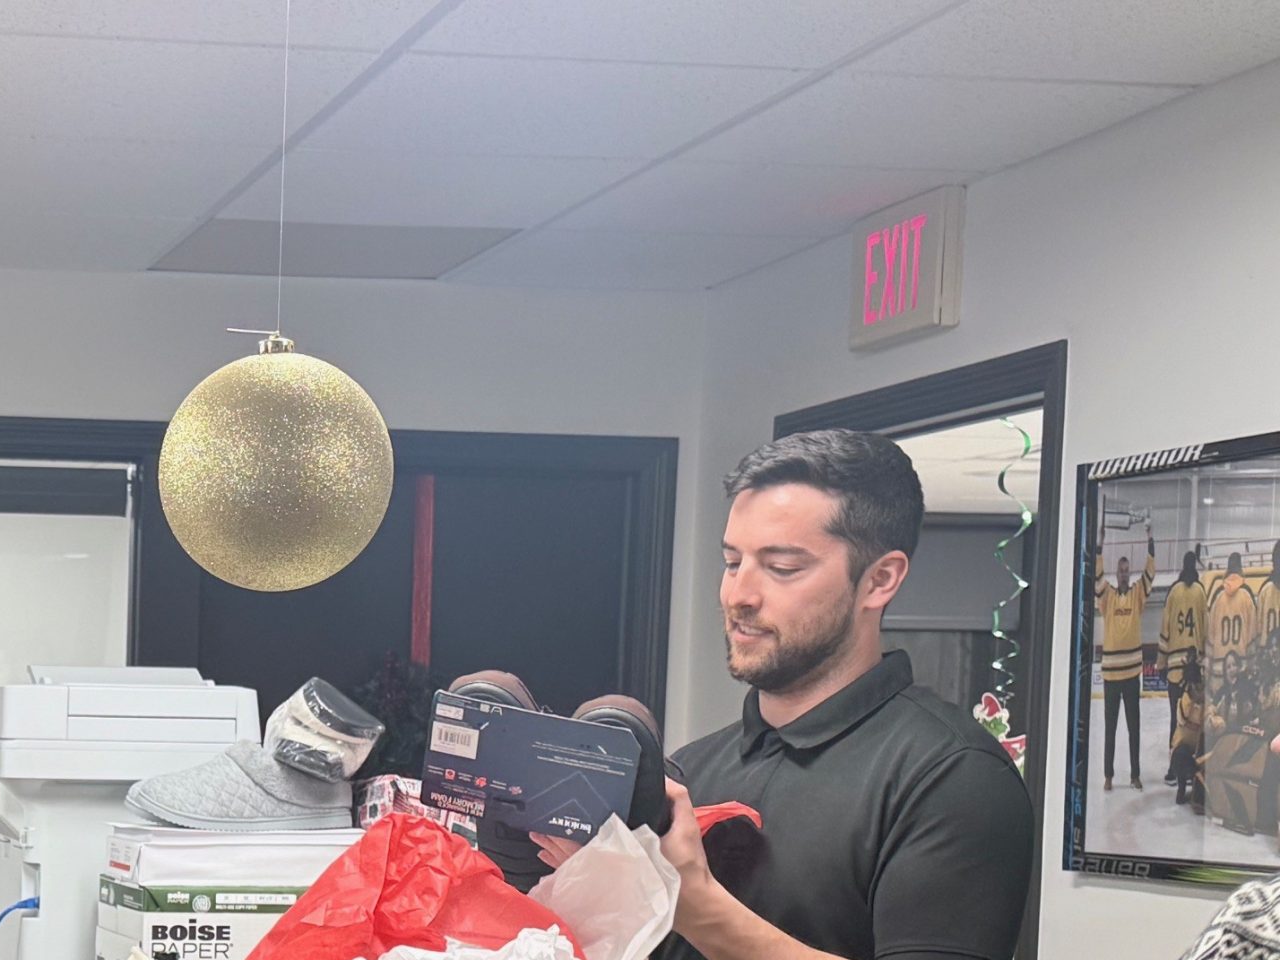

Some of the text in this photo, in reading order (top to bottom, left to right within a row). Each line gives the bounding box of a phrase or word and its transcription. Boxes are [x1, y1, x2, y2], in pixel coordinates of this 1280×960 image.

[863, 213, 928, 325] EXIT
[1087, 444, 1205, 480] WARRIOR
[1221, 614, 1242, 646] 00
